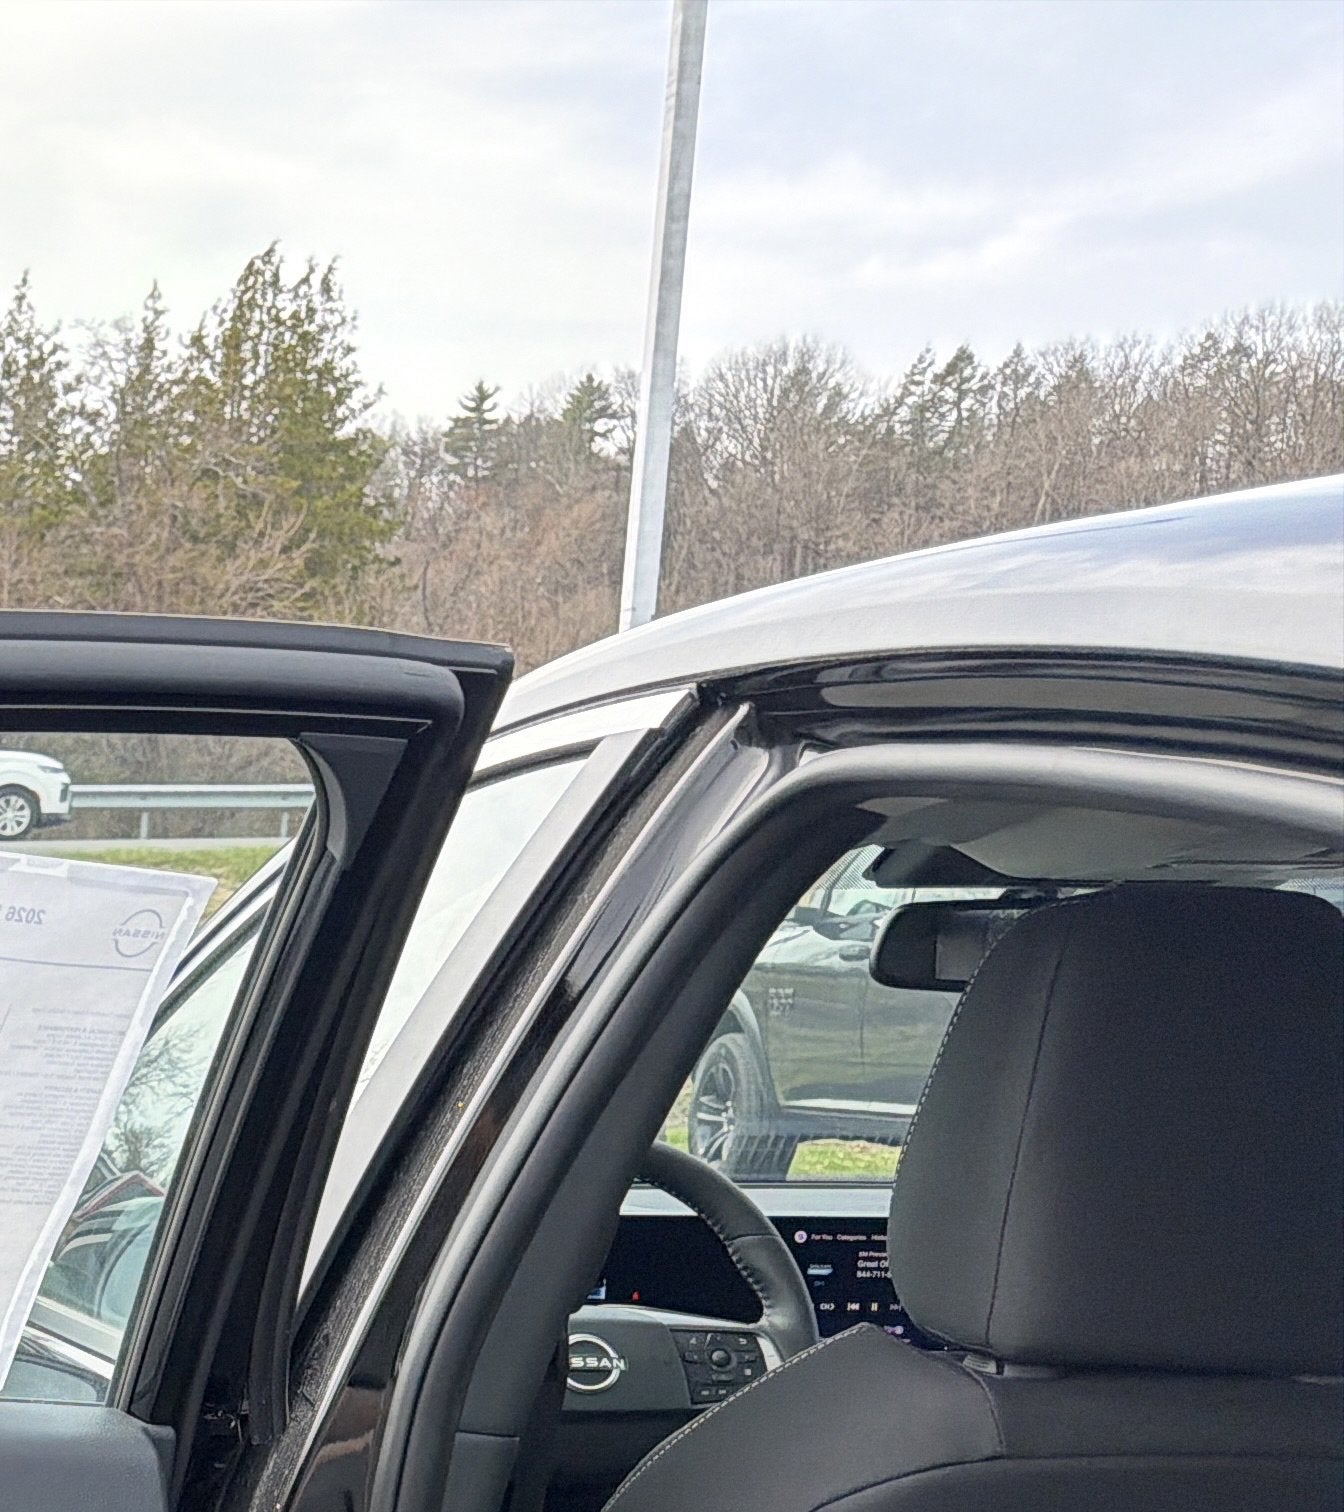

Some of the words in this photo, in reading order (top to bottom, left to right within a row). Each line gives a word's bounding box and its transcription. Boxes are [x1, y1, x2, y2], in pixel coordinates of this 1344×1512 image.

[857, 1259, 879, 1269] Great
[879, 1259, 889, 1269] Of
[570, 1356, 627, 1371] SSAN
